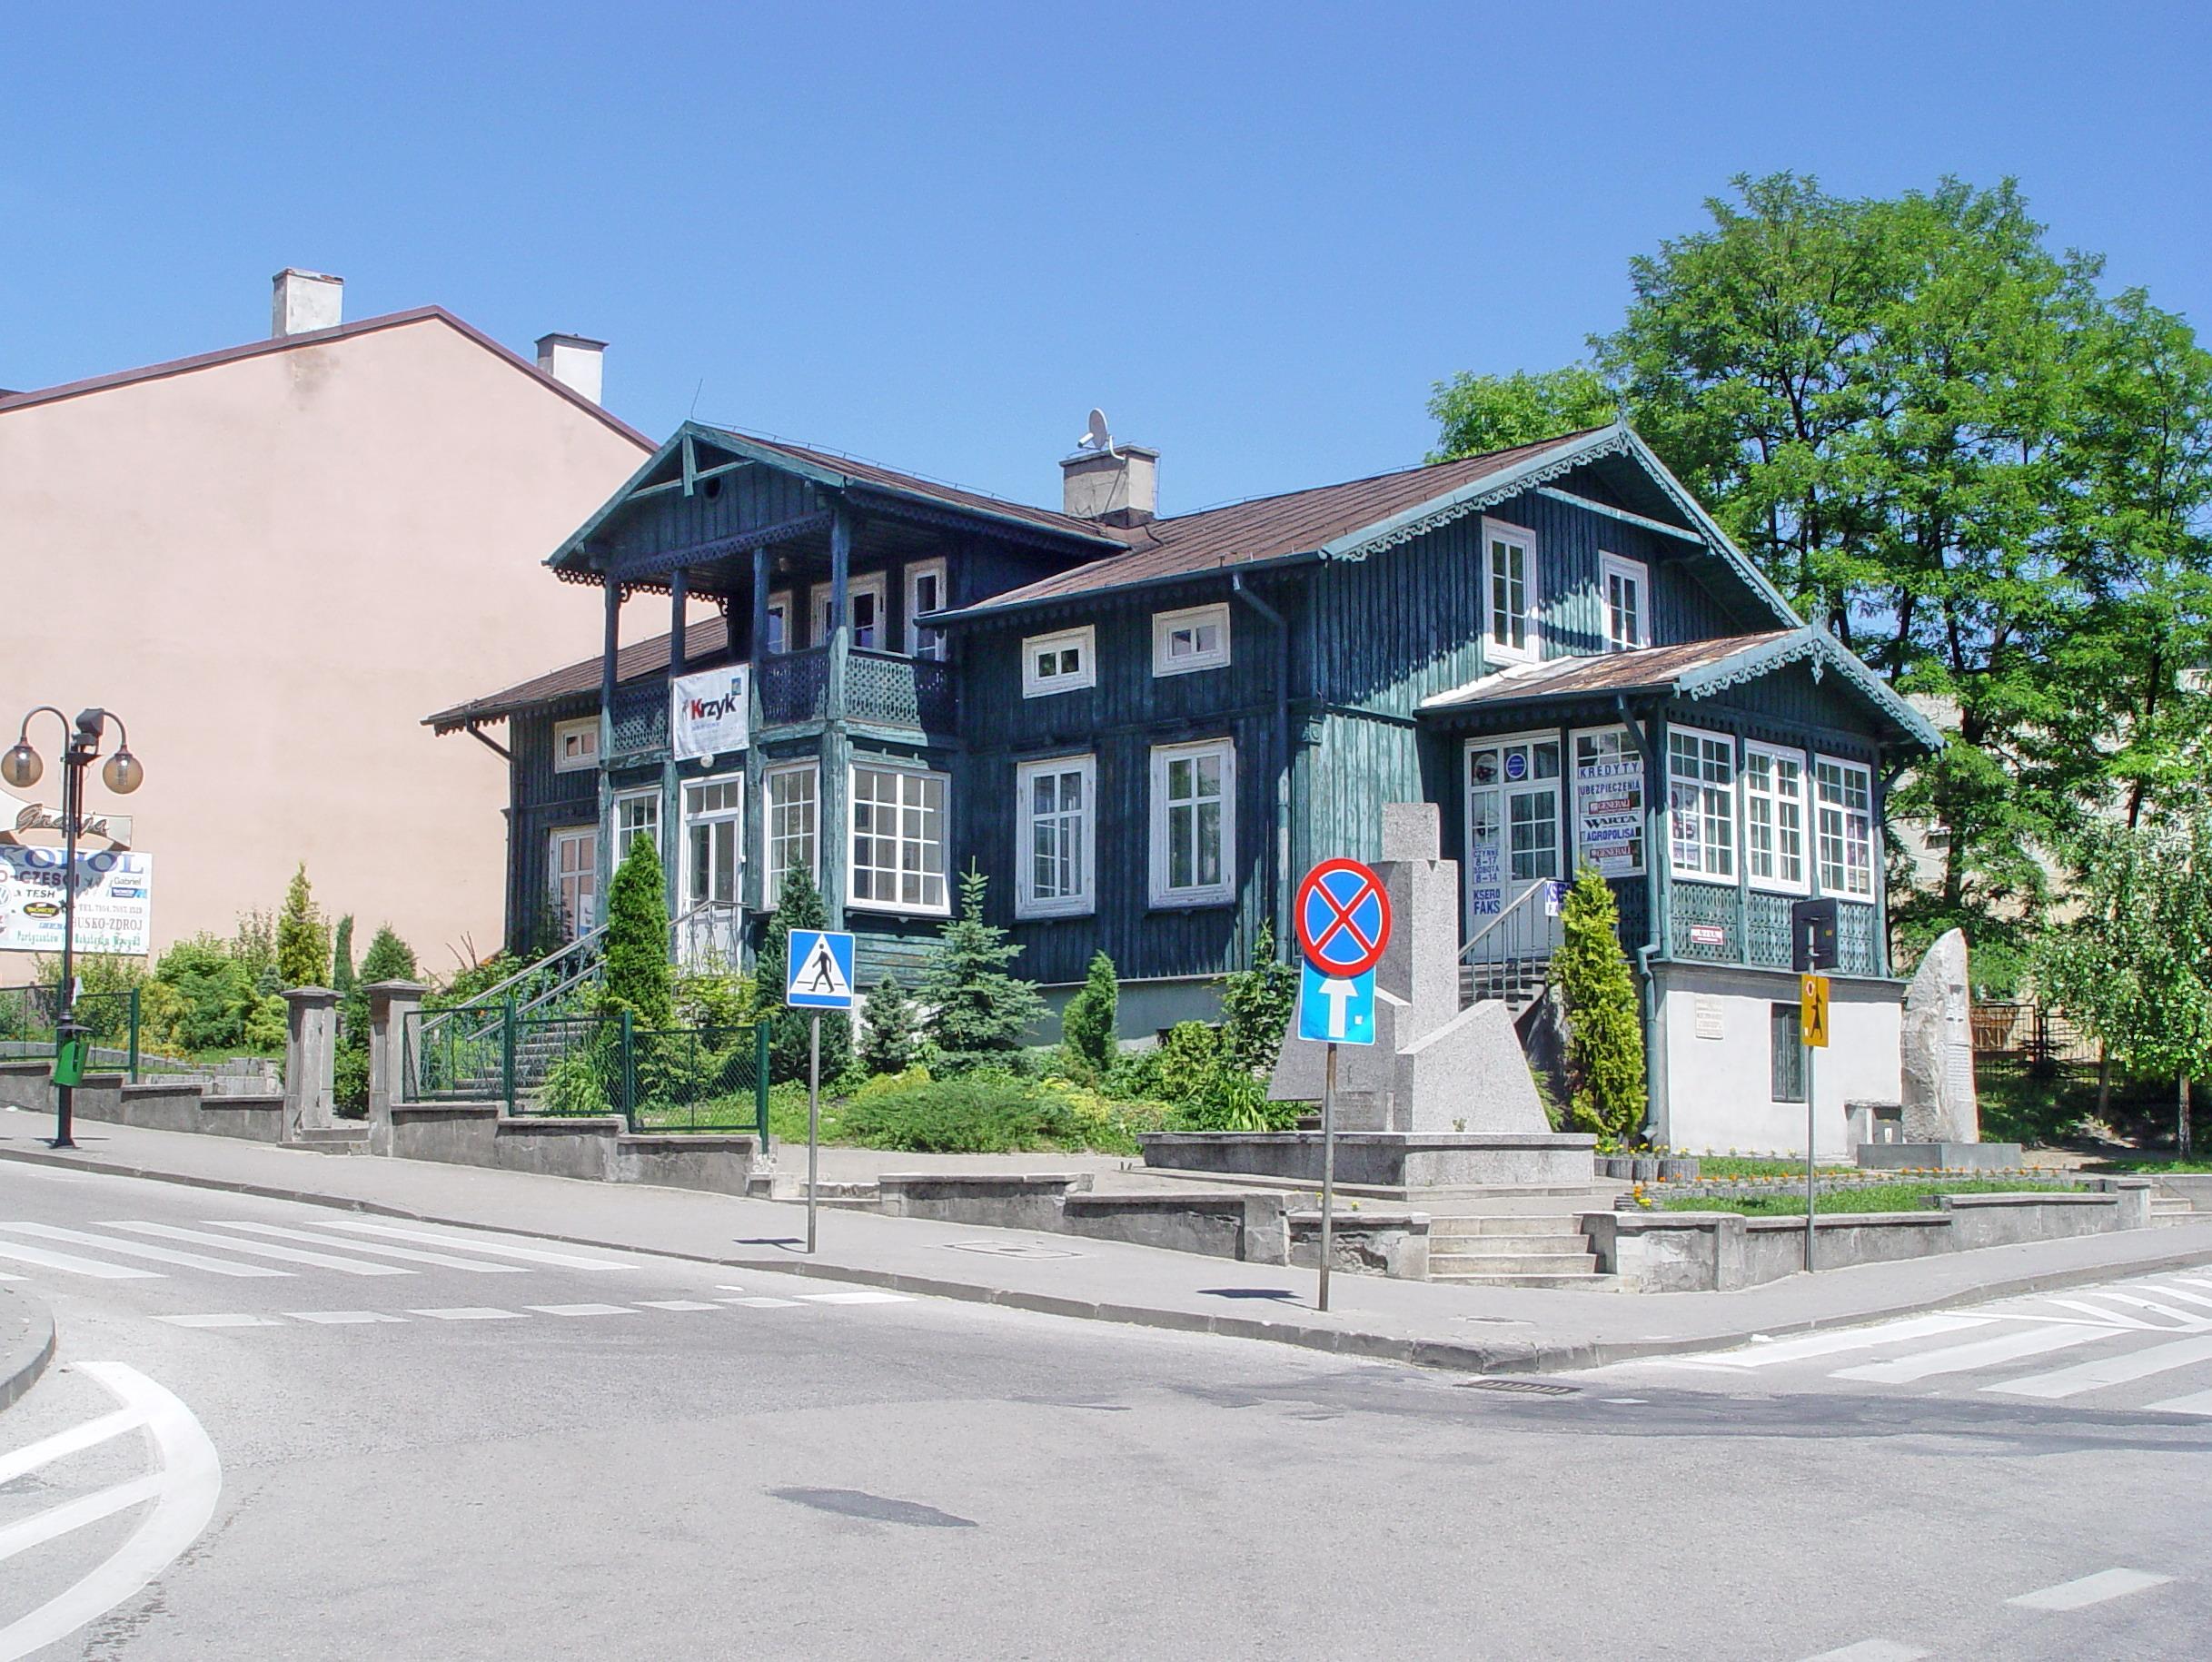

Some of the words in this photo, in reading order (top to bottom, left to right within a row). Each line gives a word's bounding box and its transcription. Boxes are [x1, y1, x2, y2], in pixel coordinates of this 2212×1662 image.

[691, 693, 736, 720] Krzyk
[1581, 763, 1638, 778] KREDYTY
[1581, 780, 1640, 796] UBEZPIECZENIA
[16, 803, 109, 836] Graja
[1583, 816, 1637, 829] WARTA
[1587, 828, 1634, 841] AGROPOLISA
[114, 877, 142, 886] Gabriel
[1473, 889, 1500, 900] KSERO
[1473, 900, 1501, 915] FAKS
